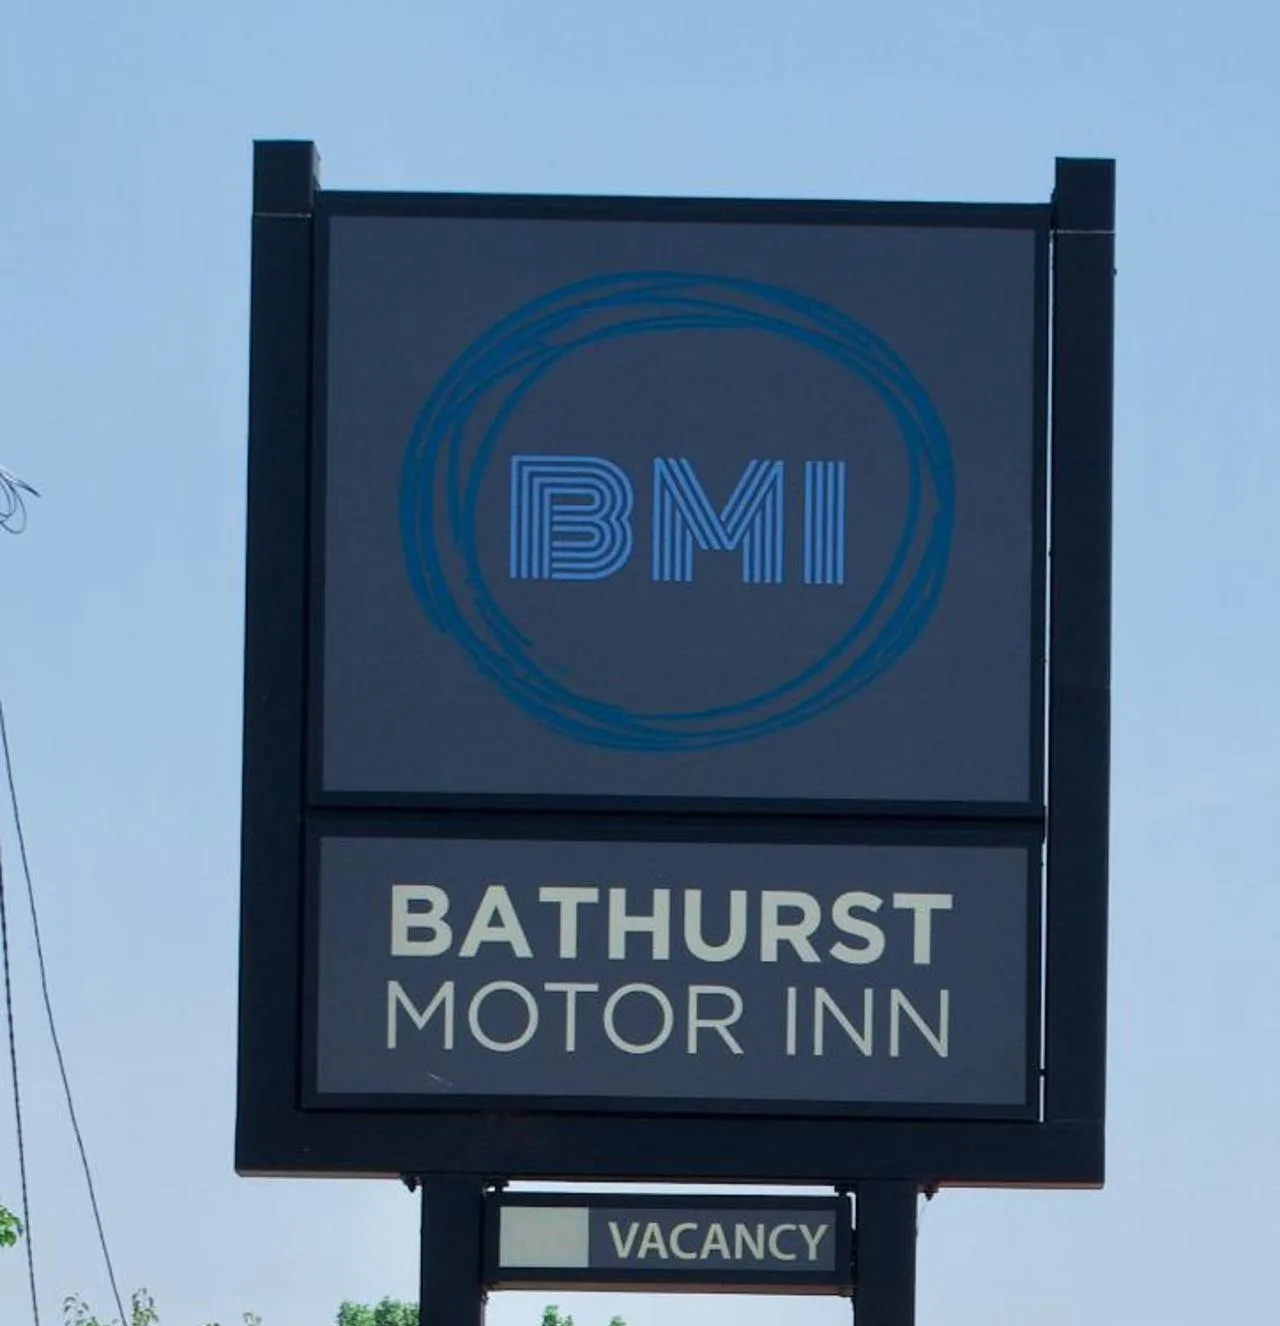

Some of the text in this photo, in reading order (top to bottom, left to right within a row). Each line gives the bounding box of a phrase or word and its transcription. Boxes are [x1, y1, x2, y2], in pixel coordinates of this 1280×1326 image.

[509, 455, 846, 585] BMI
[390, 884, 954, 965] BATHURST
[385, 980, 950, 1059] MOTOR INN
[608, 1220, 828, 1262] VACANCY
